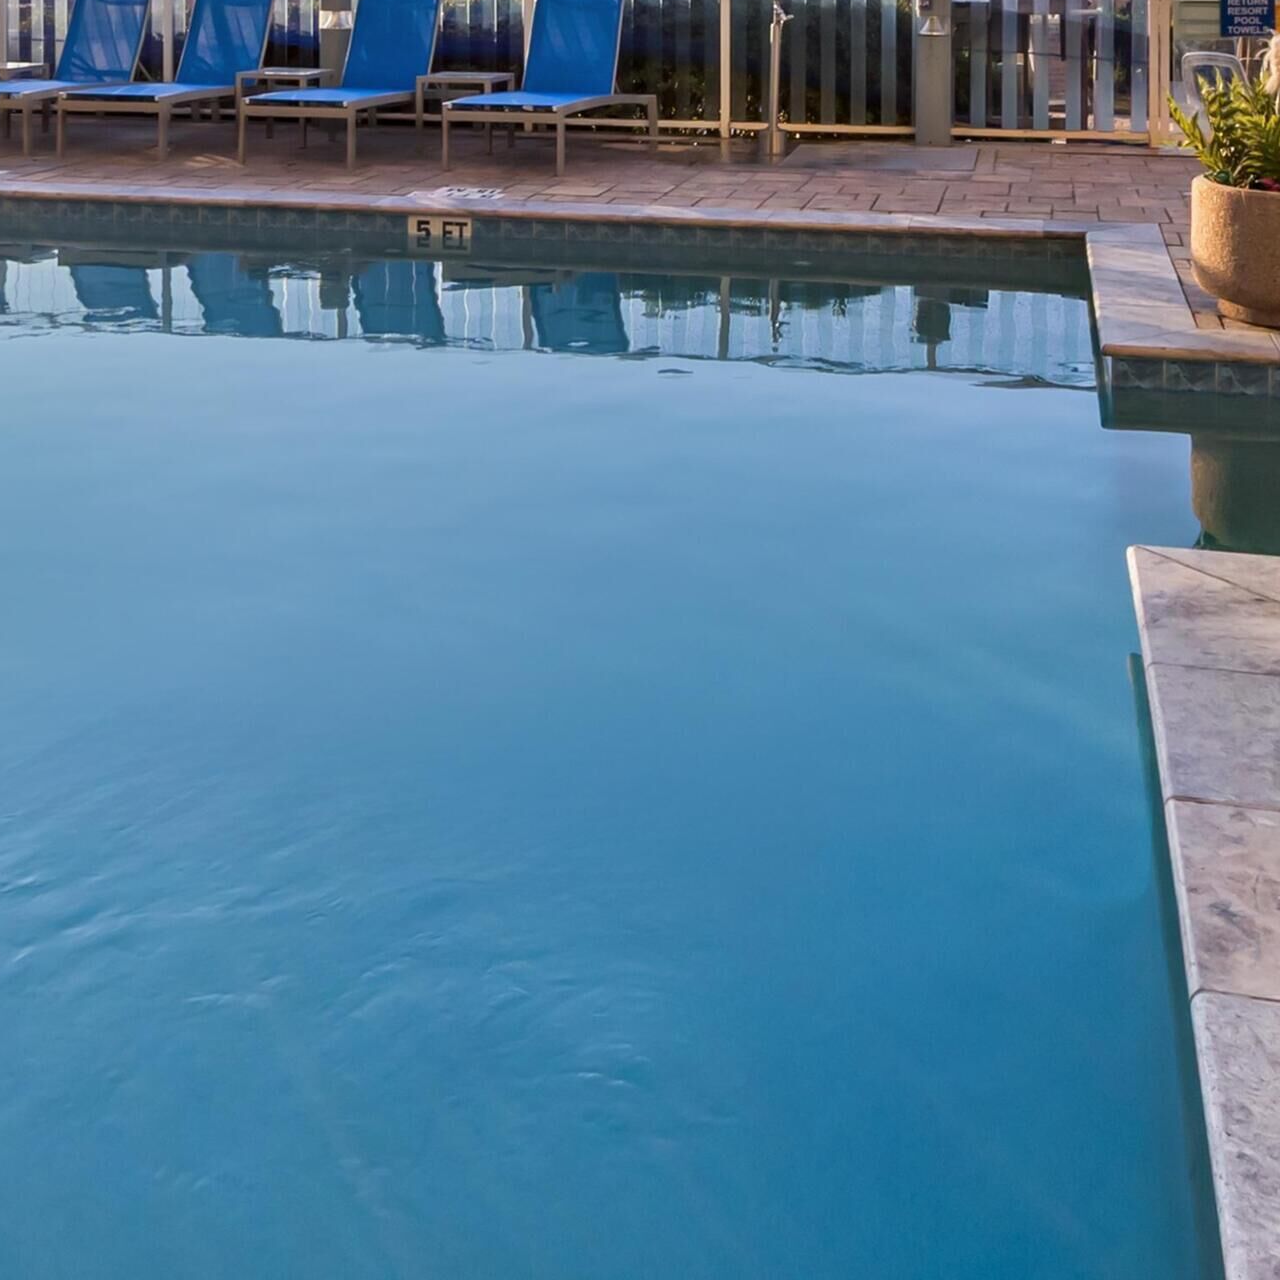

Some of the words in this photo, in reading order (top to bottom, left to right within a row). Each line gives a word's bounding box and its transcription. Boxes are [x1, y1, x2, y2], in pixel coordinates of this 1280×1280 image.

[1227, 7, 1268, 16] RESORT
[1234, 16, 1262, 25] POOL
[1227, 26, 1269, 35] TOWELS
[417, 220, 431, 238] 5
